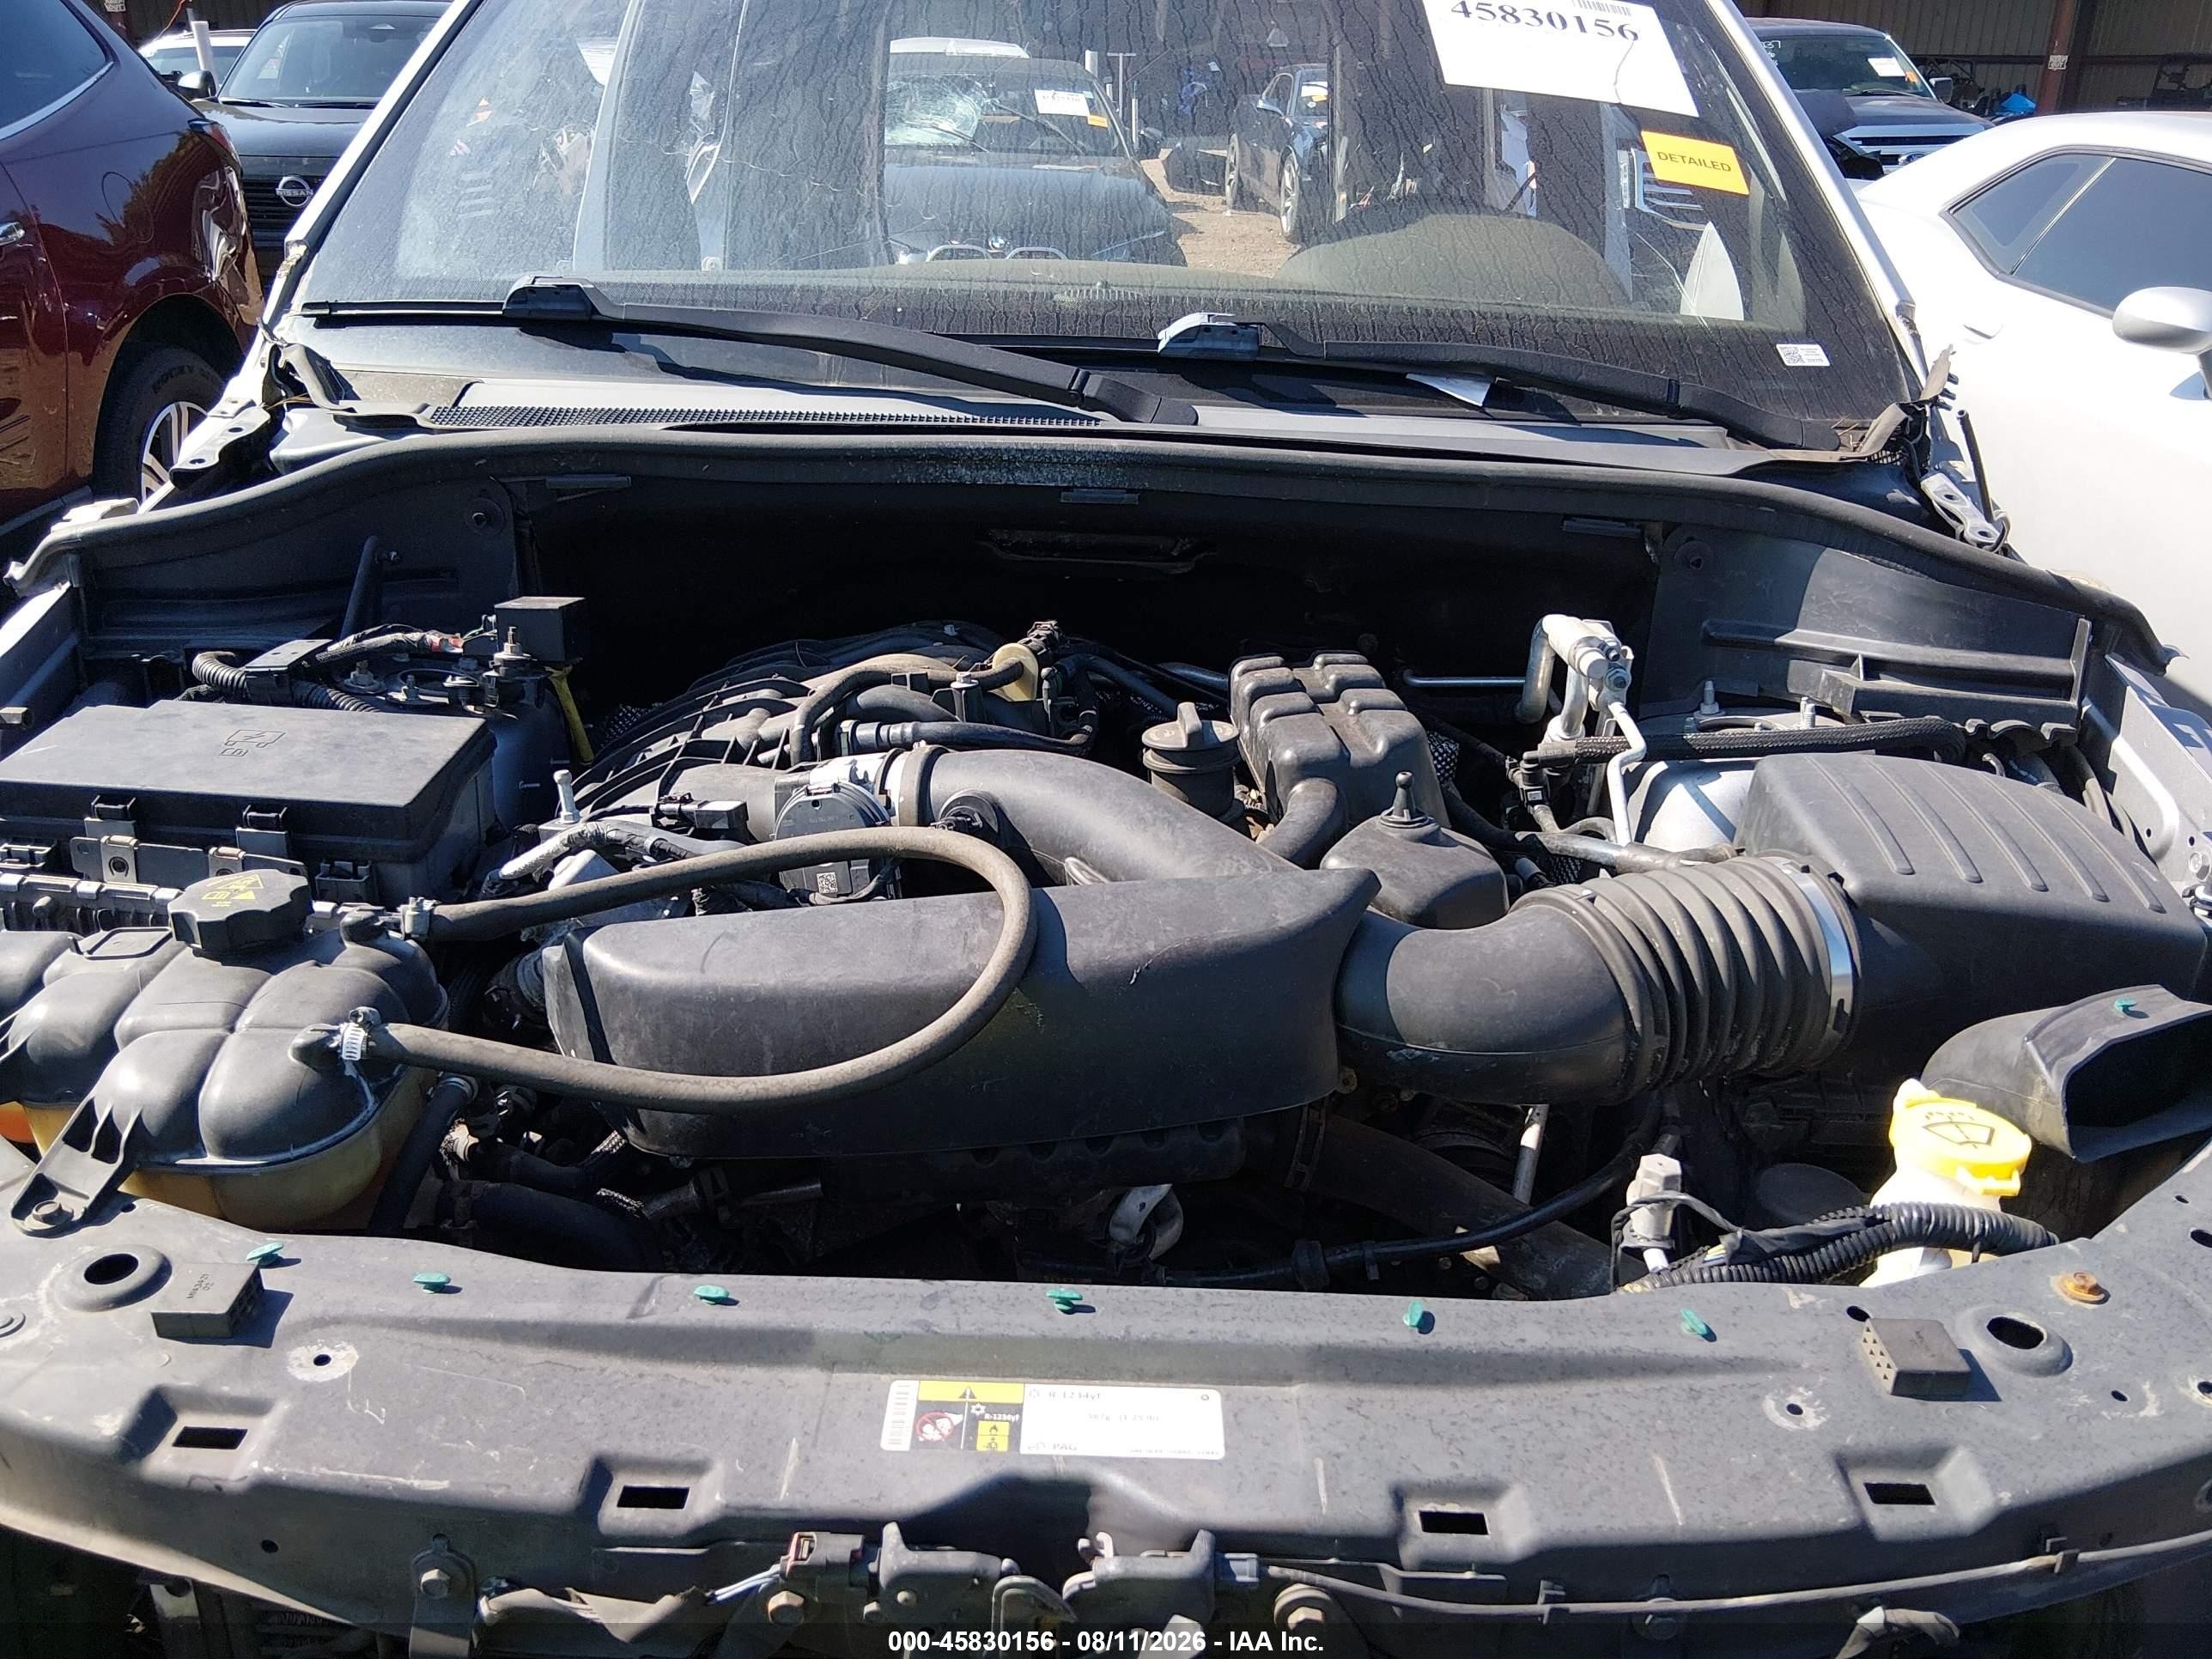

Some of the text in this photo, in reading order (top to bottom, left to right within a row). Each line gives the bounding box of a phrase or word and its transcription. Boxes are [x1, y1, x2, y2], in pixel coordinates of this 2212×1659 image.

[1450, 1, 1639, 41] 45830156
[1656, 151, 1732, 172] DETAILED
[1052, 1442, 1079, 1451] PAG
